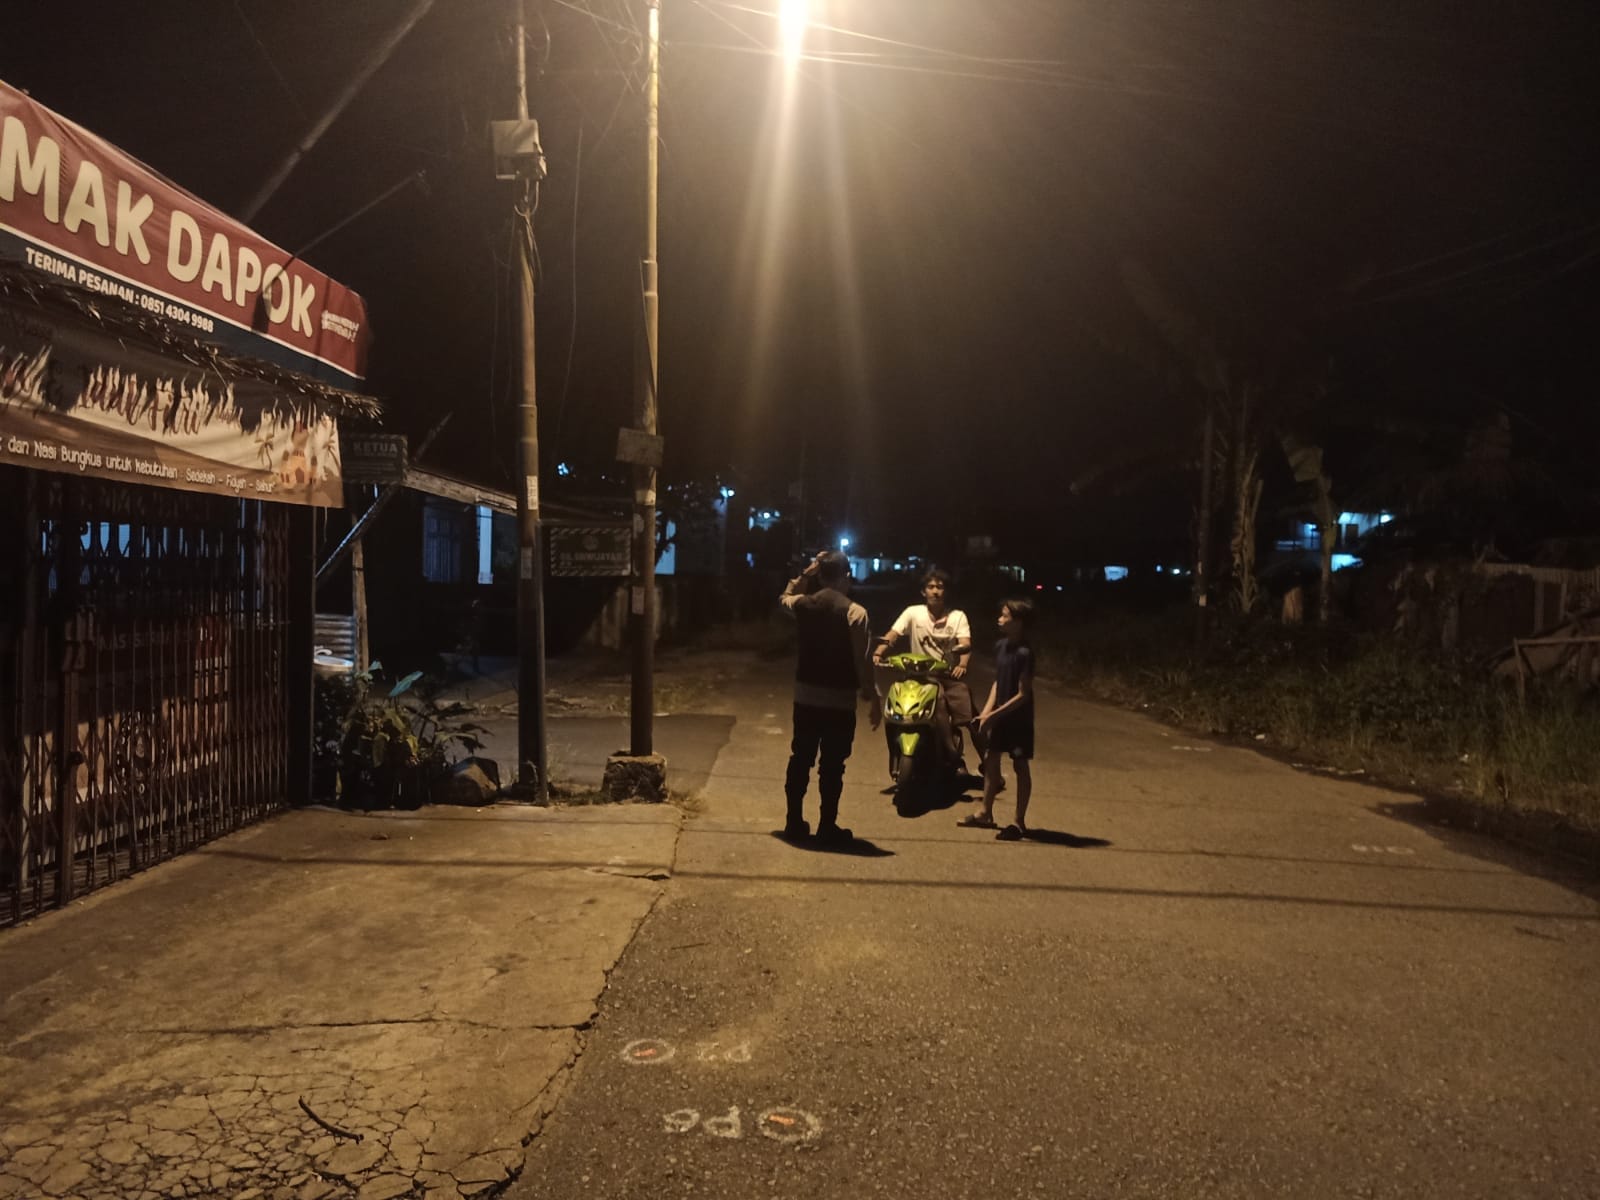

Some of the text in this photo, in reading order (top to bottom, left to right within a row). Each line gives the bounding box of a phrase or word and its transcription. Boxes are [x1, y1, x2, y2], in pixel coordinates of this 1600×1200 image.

[0, 115, 317, 338] MAK DAPOK
[25, 246, 77, 282] TERIMA
[78, 268, 134, 303] PESANAN
[141, 294, 165, 315] 0851
[165, 306, 190, 325] 4304
[191, 315, 214, 333] 9988
[7, 435, 29, 455] dan
[33, 440, 57, 460] Nasi
[61, 445, 102, 471] Bungkus
[105, 455, 132, 473] untuk
[353, 442, 398, 453] KETUA
